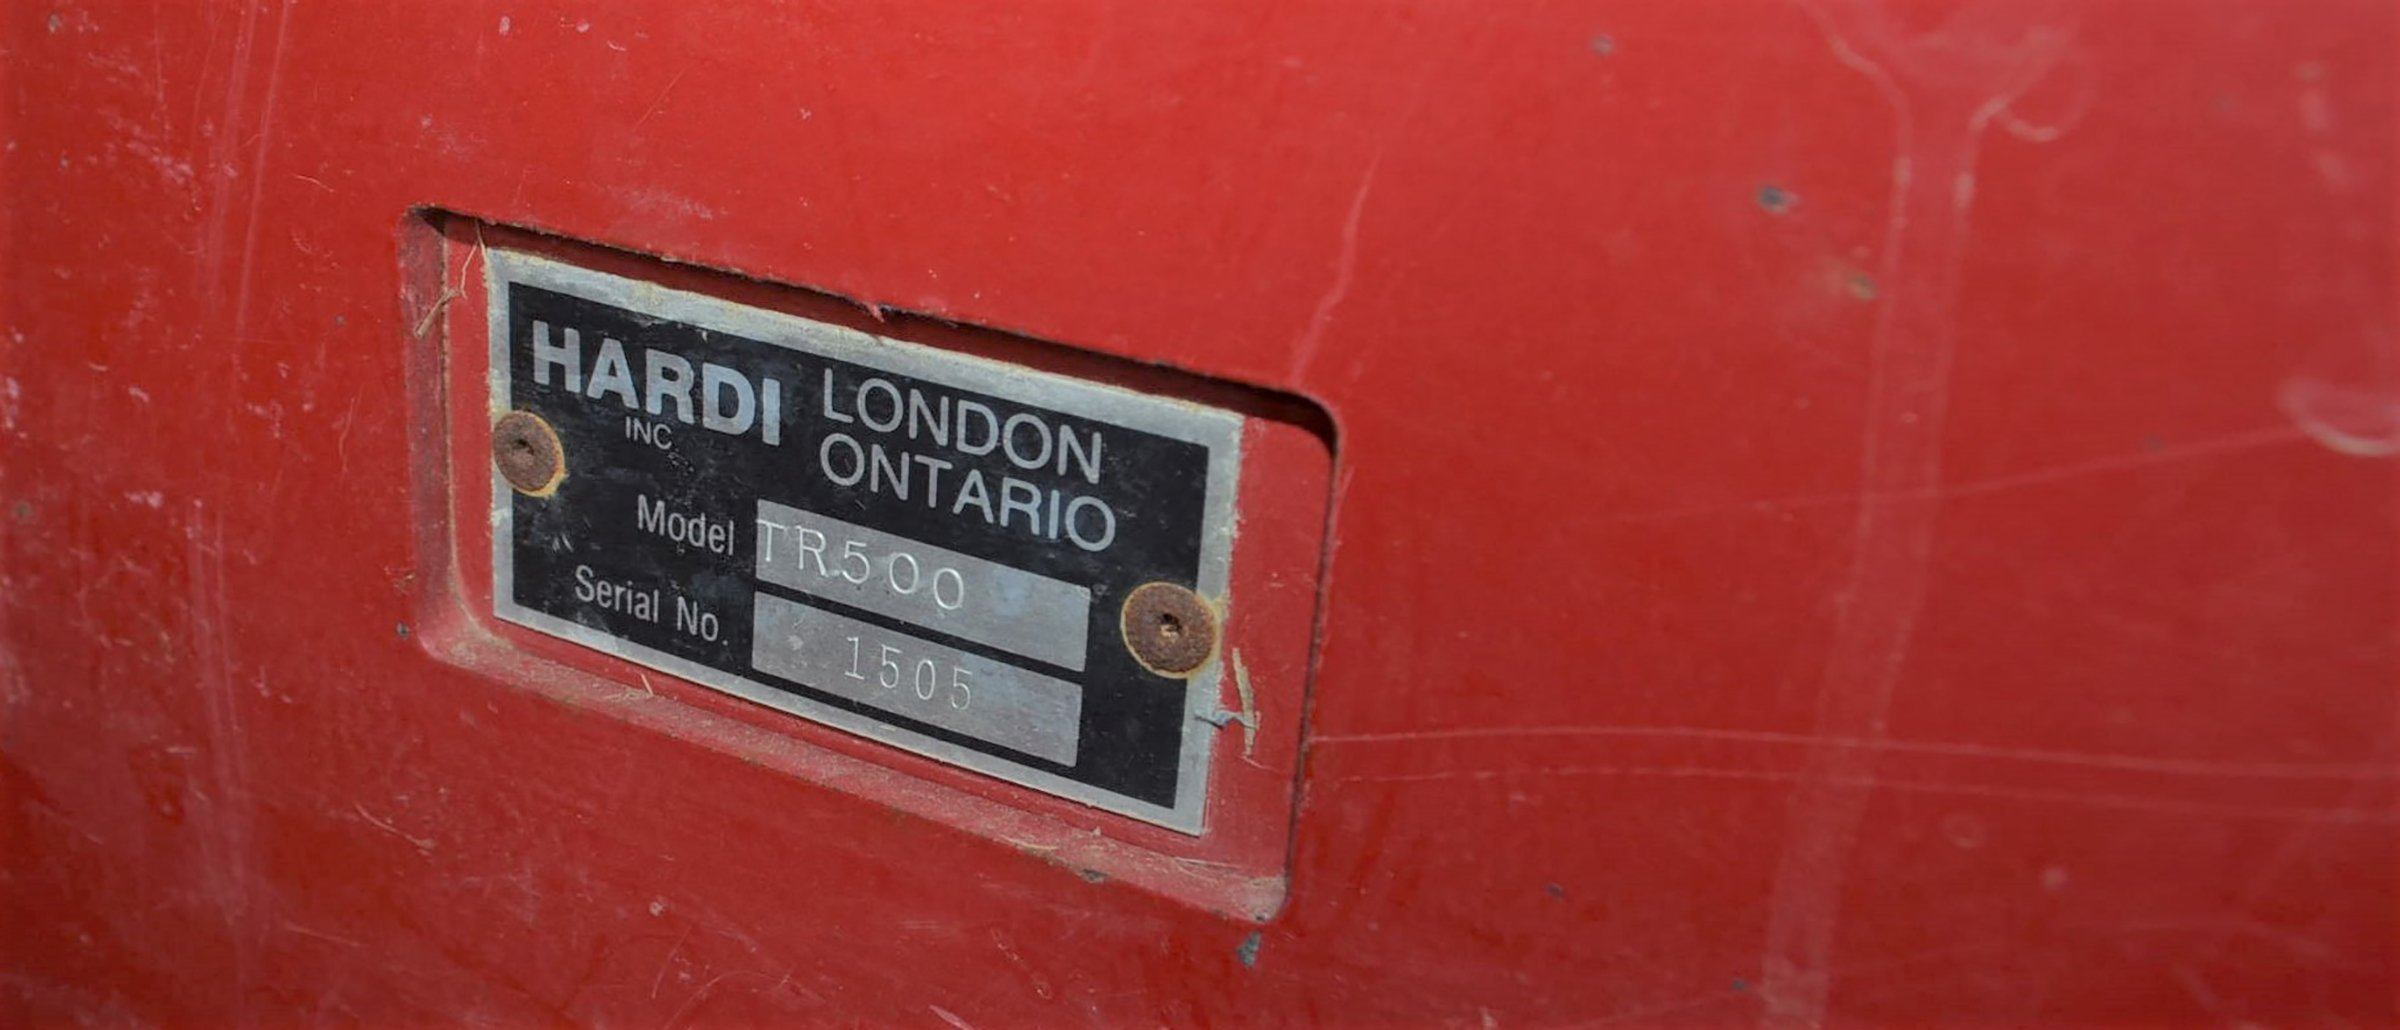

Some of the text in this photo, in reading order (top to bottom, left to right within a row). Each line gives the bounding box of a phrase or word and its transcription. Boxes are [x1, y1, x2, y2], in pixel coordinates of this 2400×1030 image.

[532, 320, 781, 446] HARDI
[823, 368, 1102, 484] LONDON
[637, 494, 964, 610] Model TR500
[820, 433, 1116, 552] ONTARIO
[574, 565, 973, 711] Serial No. 1505
